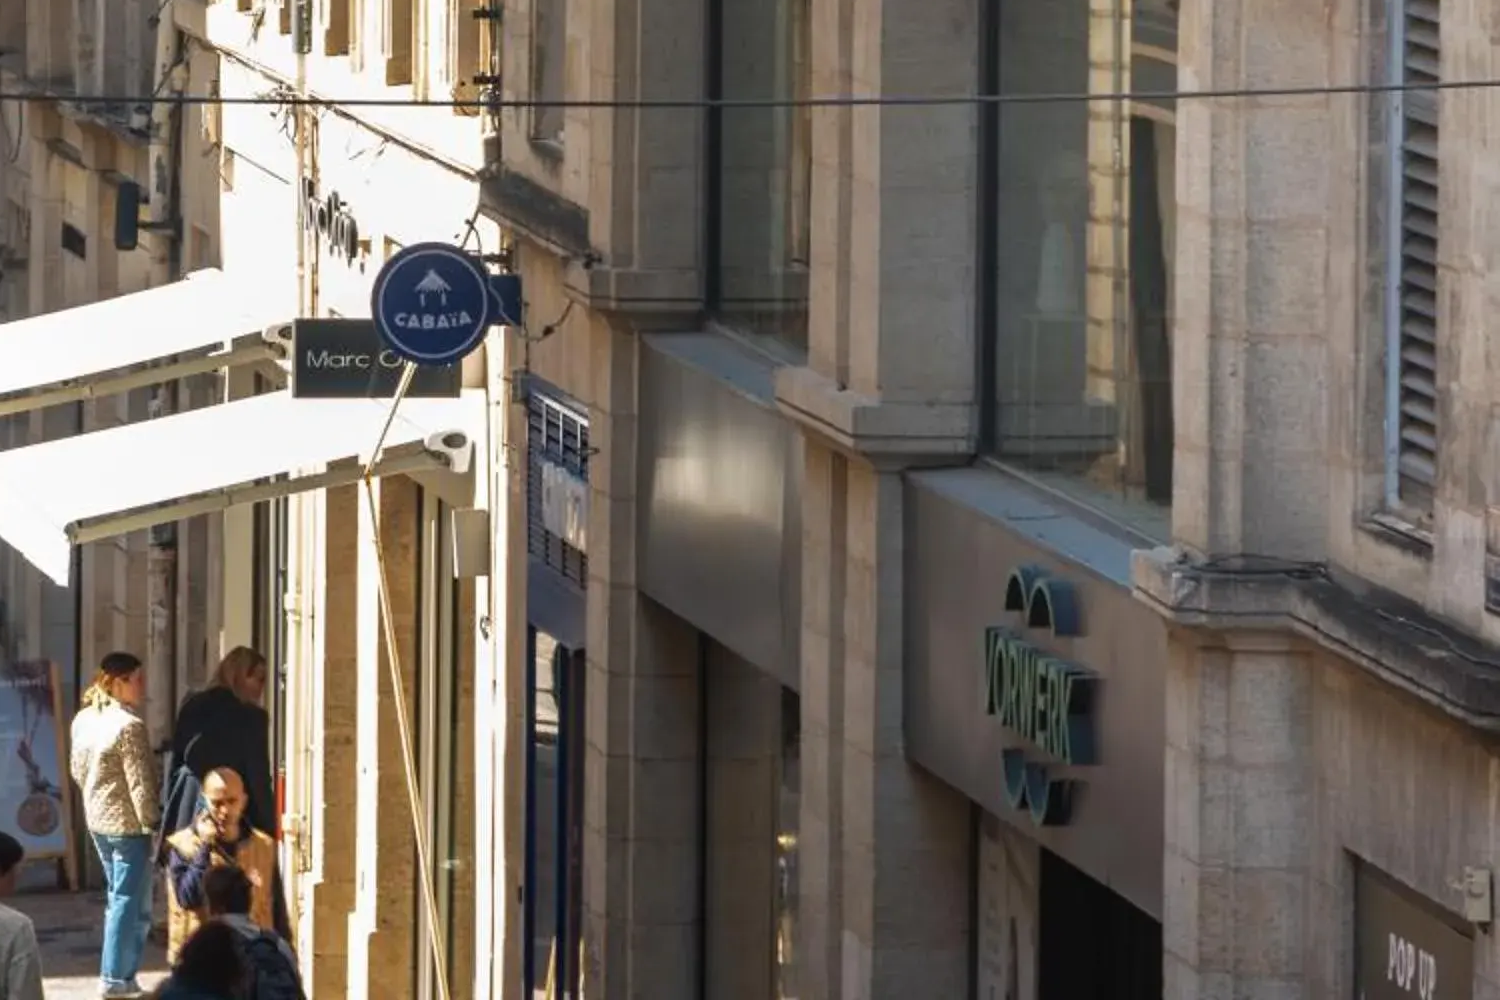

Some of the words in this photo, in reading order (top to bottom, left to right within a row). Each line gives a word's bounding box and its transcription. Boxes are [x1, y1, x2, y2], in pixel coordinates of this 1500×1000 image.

[306, 349, 370, 369] Marc
[984, 628, 1074, 767] VORWERK
[1387, 931, 1415, 992] POP
[1419, 948, 1438, 1000] UP
